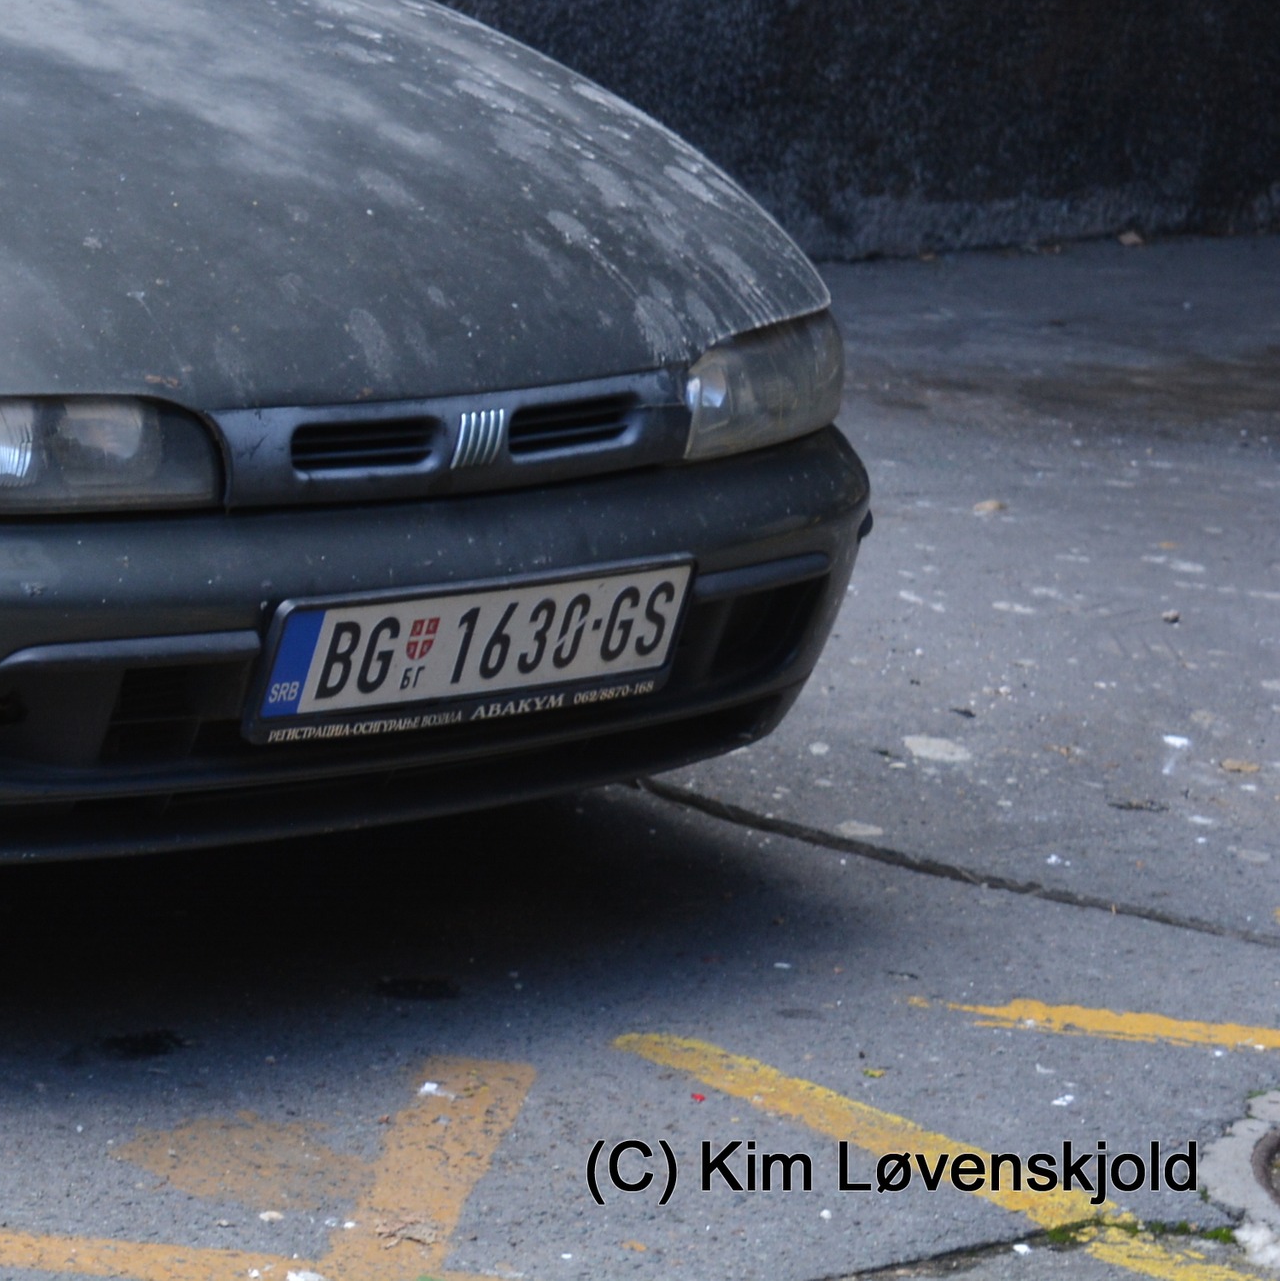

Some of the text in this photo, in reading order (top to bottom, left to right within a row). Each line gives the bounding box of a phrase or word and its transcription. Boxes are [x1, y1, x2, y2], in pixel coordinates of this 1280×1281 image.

[313, 616, 400, 701] BG
[399, 664, 427, 690] БГ
[268, 680, 300, 703] SRB
